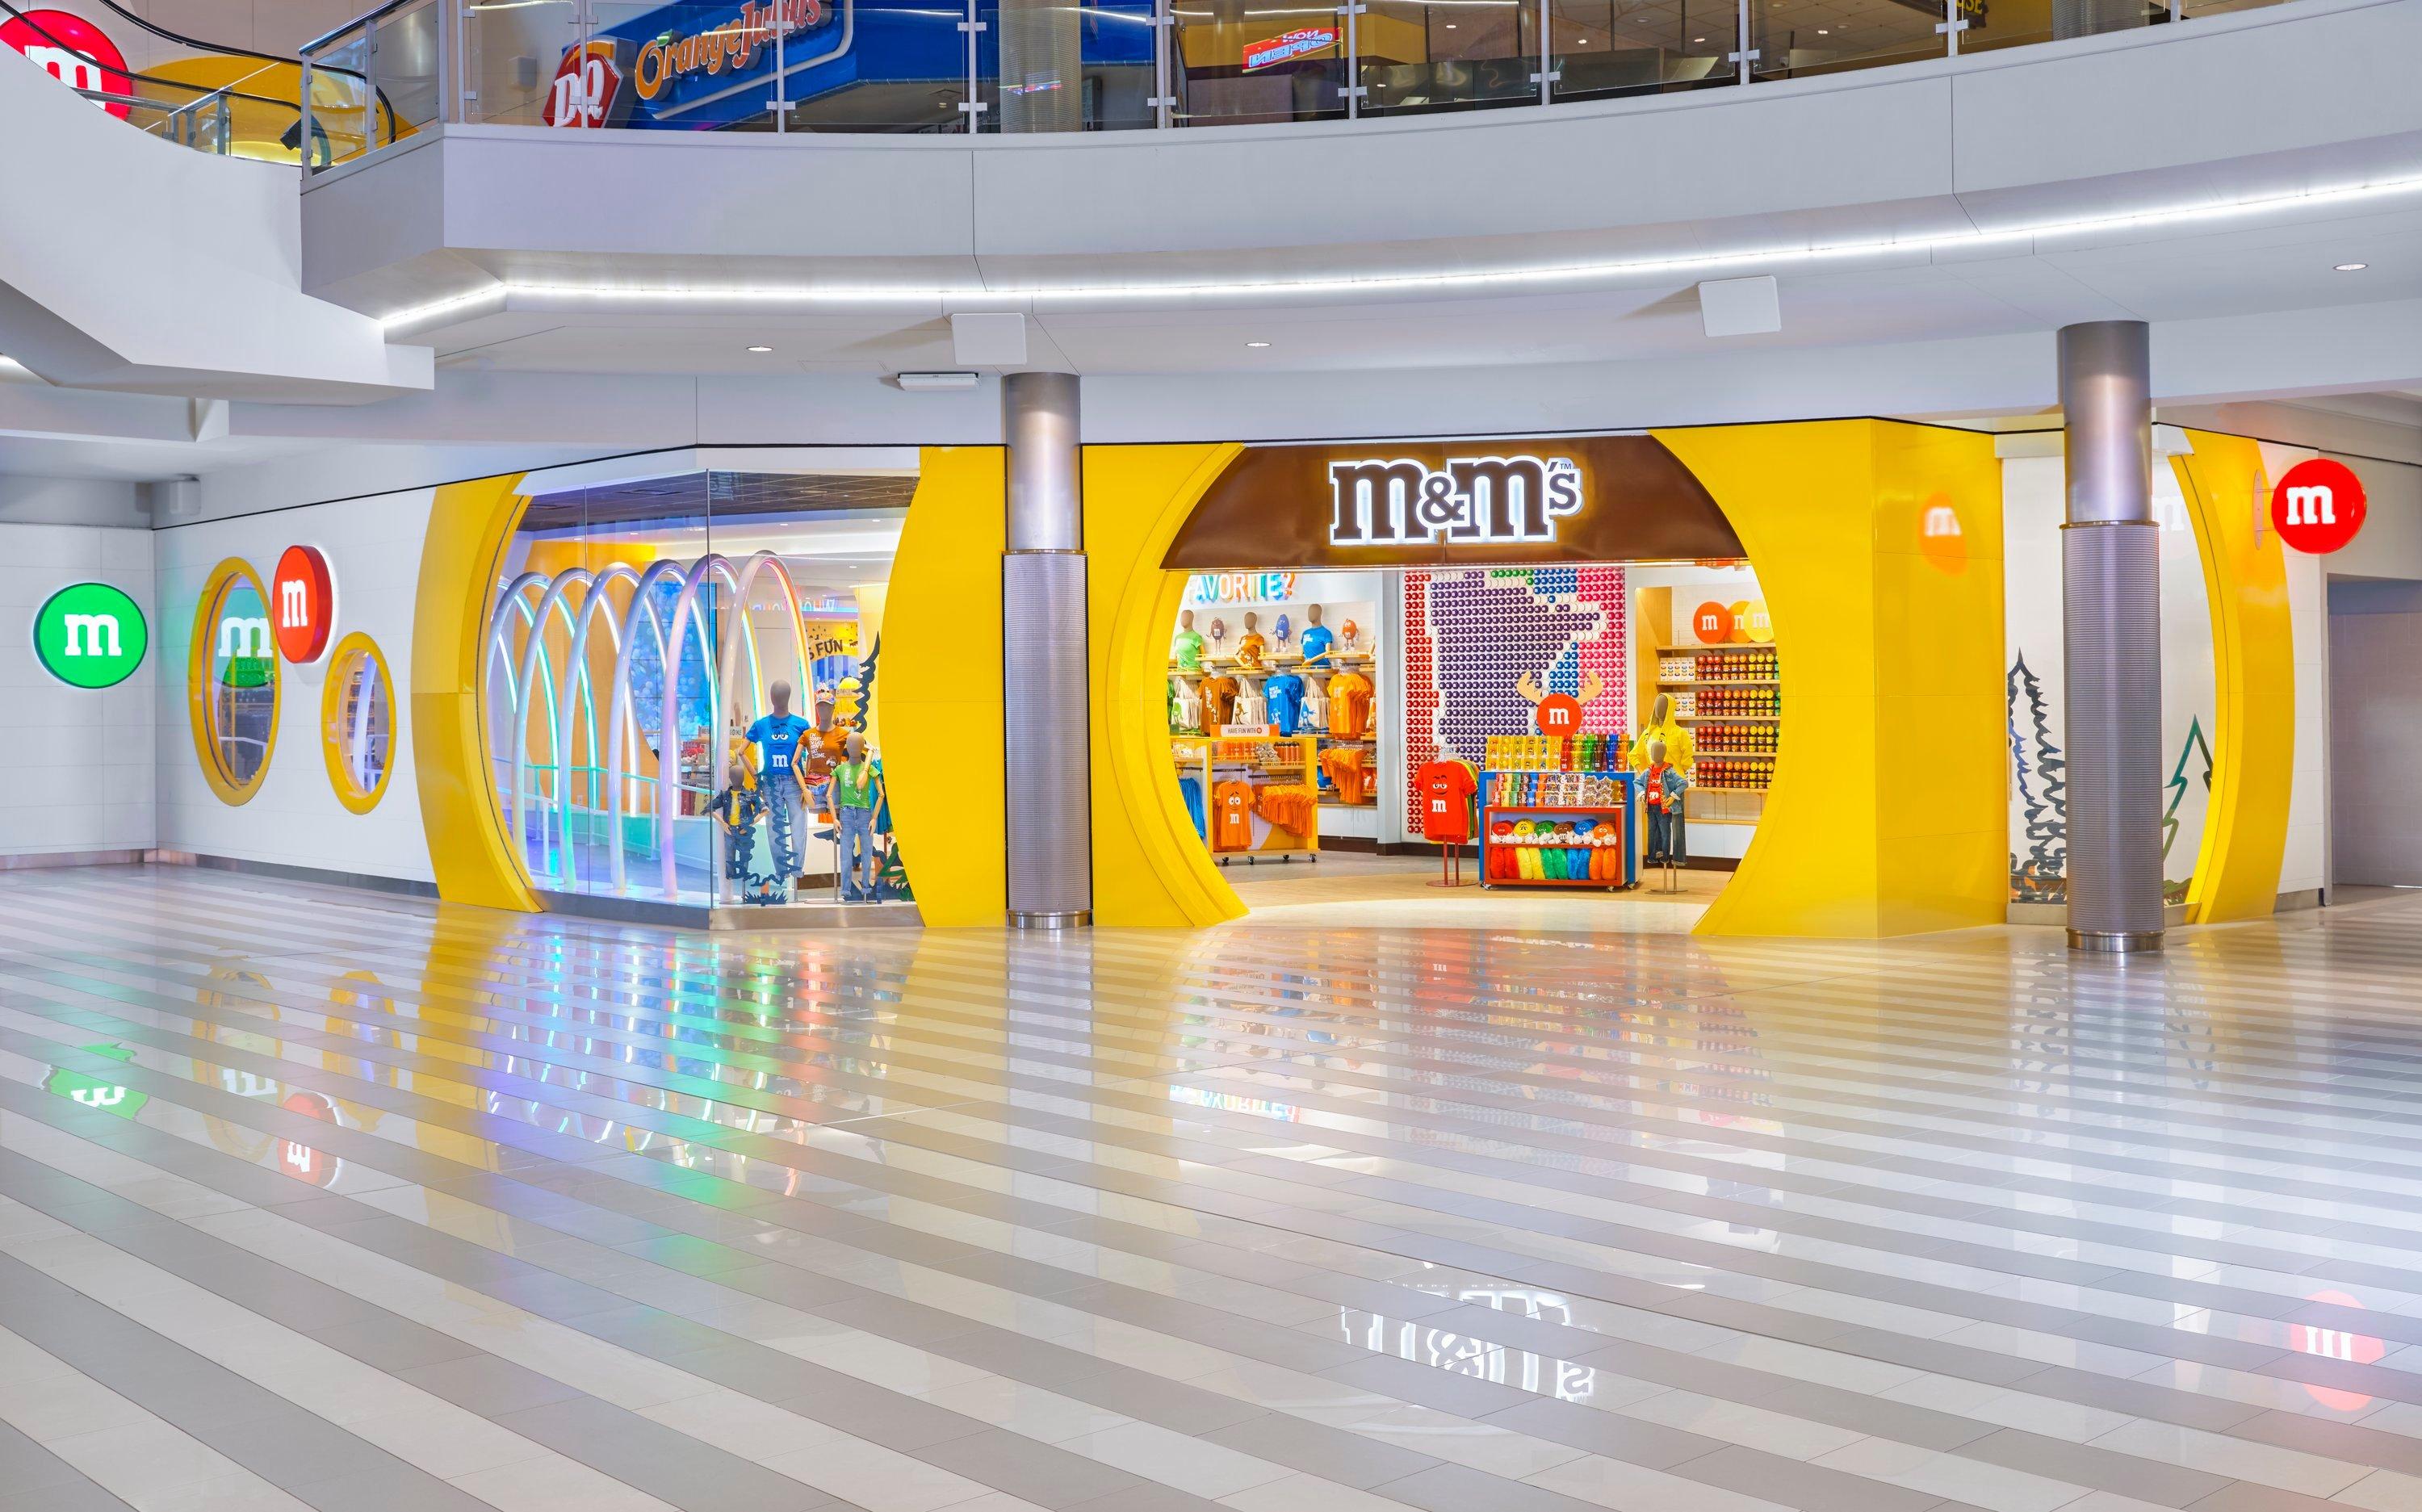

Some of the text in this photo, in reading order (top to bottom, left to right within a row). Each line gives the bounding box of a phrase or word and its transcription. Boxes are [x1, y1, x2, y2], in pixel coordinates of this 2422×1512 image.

[635, 19, 743, 99] Orange
[553, 59, 604, 128] DQ
[2286, 485, 2336, 525] m
[281, 579, 308, 627] m
[1702, 614, 1718, 630] m
[65, 614, 122, 656] m
[815, 639, 843, 656] FUN
[1548, 708, 1569, 725] m
[772, 754, 788, 767] m
[1431, 799, 1447, 813] m
[1230, 813, 1239, 824] m
